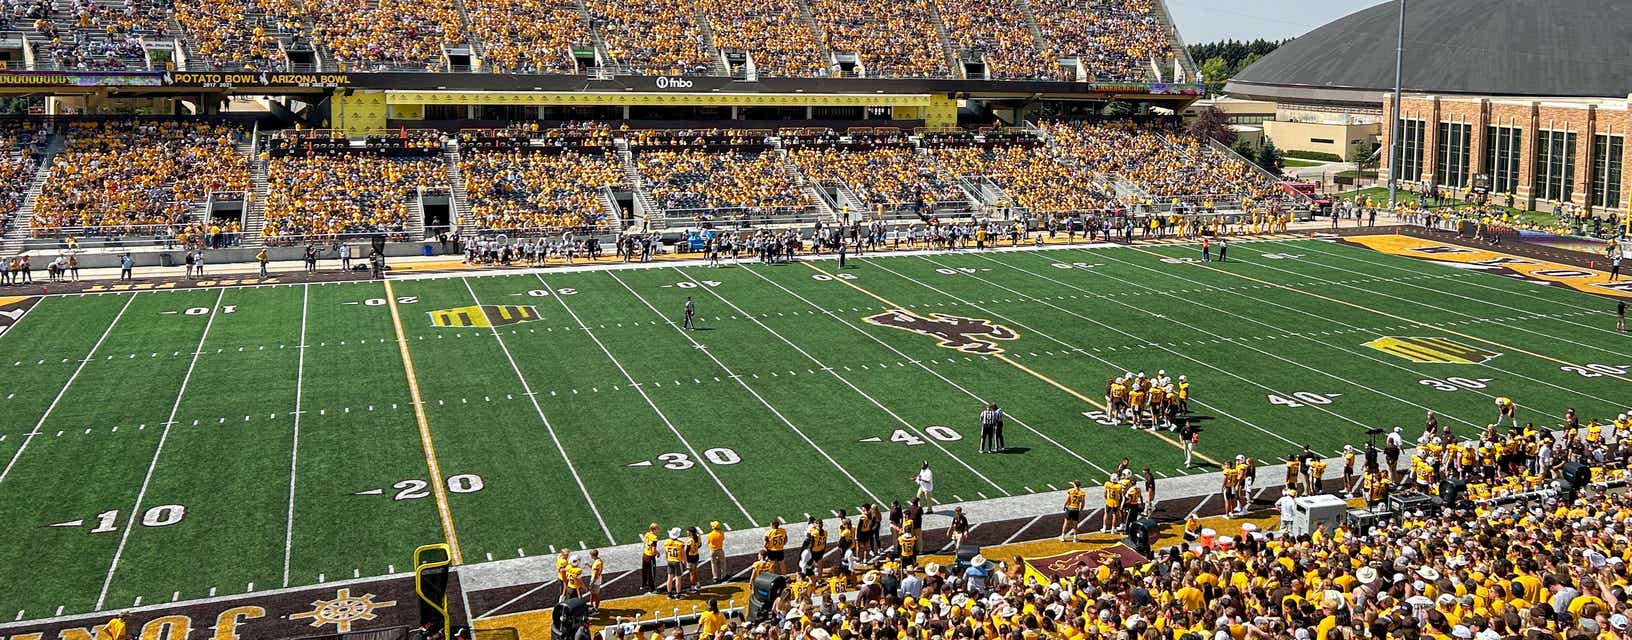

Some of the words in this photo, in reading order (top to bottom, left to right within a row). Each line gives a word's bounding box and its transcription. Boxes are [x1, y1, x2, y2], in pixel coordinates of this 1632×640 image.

[174, 74, 221, 83] POTATO
[224, 74, 258, 84] BOWL
[271, 74, 317, 84] ARIZONA
[320, 74, 351, 84] BOWL
[669, 78, 693, 88] fnbo
[812, 273, 859, 282] 50
[676, 279, 723, 289] 40
[527, 287, 578, 298] 30
[364, 296, 418, 306] 20
[184, 304, 237, 315] 10
[1560, 363, 1628, 378] 20
[1418, 376, 1488, 392] 30
[1267, 390, 1334, 408] 40
[889, 425, 963, 447] 40
[656, 447, 743, 470] 30
[392, 473, 486, 501] 20
[88, 504, 188, 535] 10
